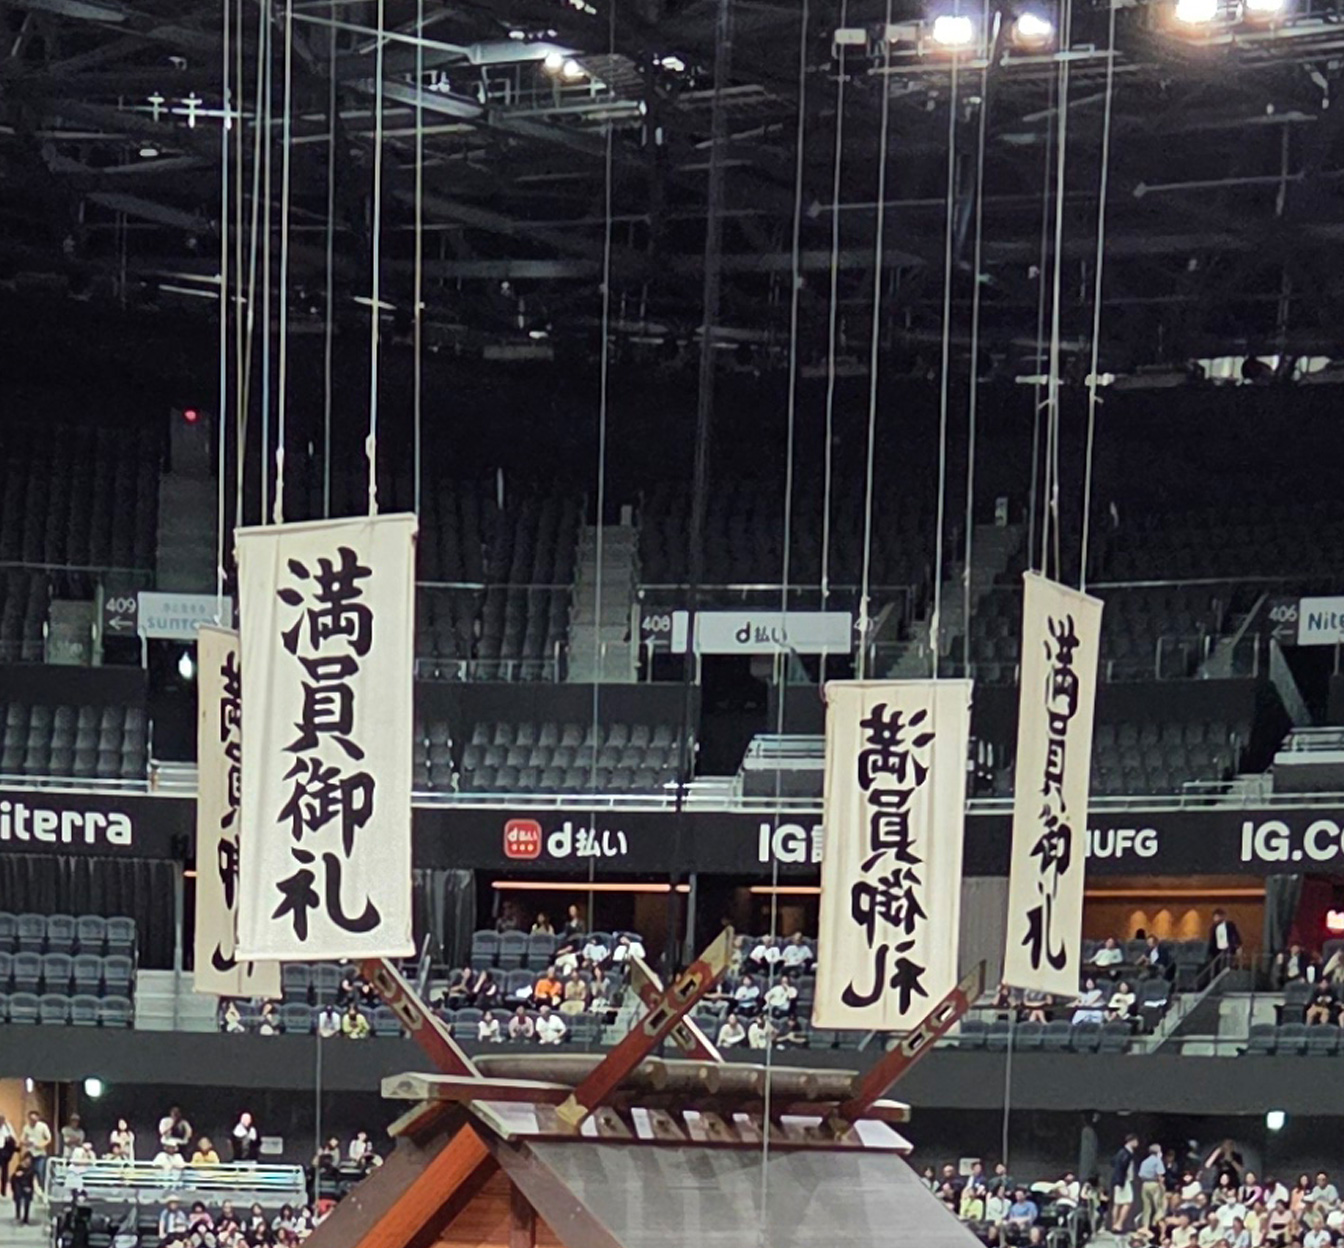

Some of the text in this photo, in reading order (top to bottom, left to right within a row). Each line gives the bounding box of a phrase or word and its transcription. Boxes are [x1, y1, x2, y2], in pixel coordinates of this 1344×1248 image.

[106, 597, 136, 613] 409
[1268, 604, 1297, 622] 406
[642, 615, 671, 632] 408
[271, 546, 381, 941] 満員御礼
[547, 821, 628, 858] d払い
[1085, 829, 1158, 858] UFG
